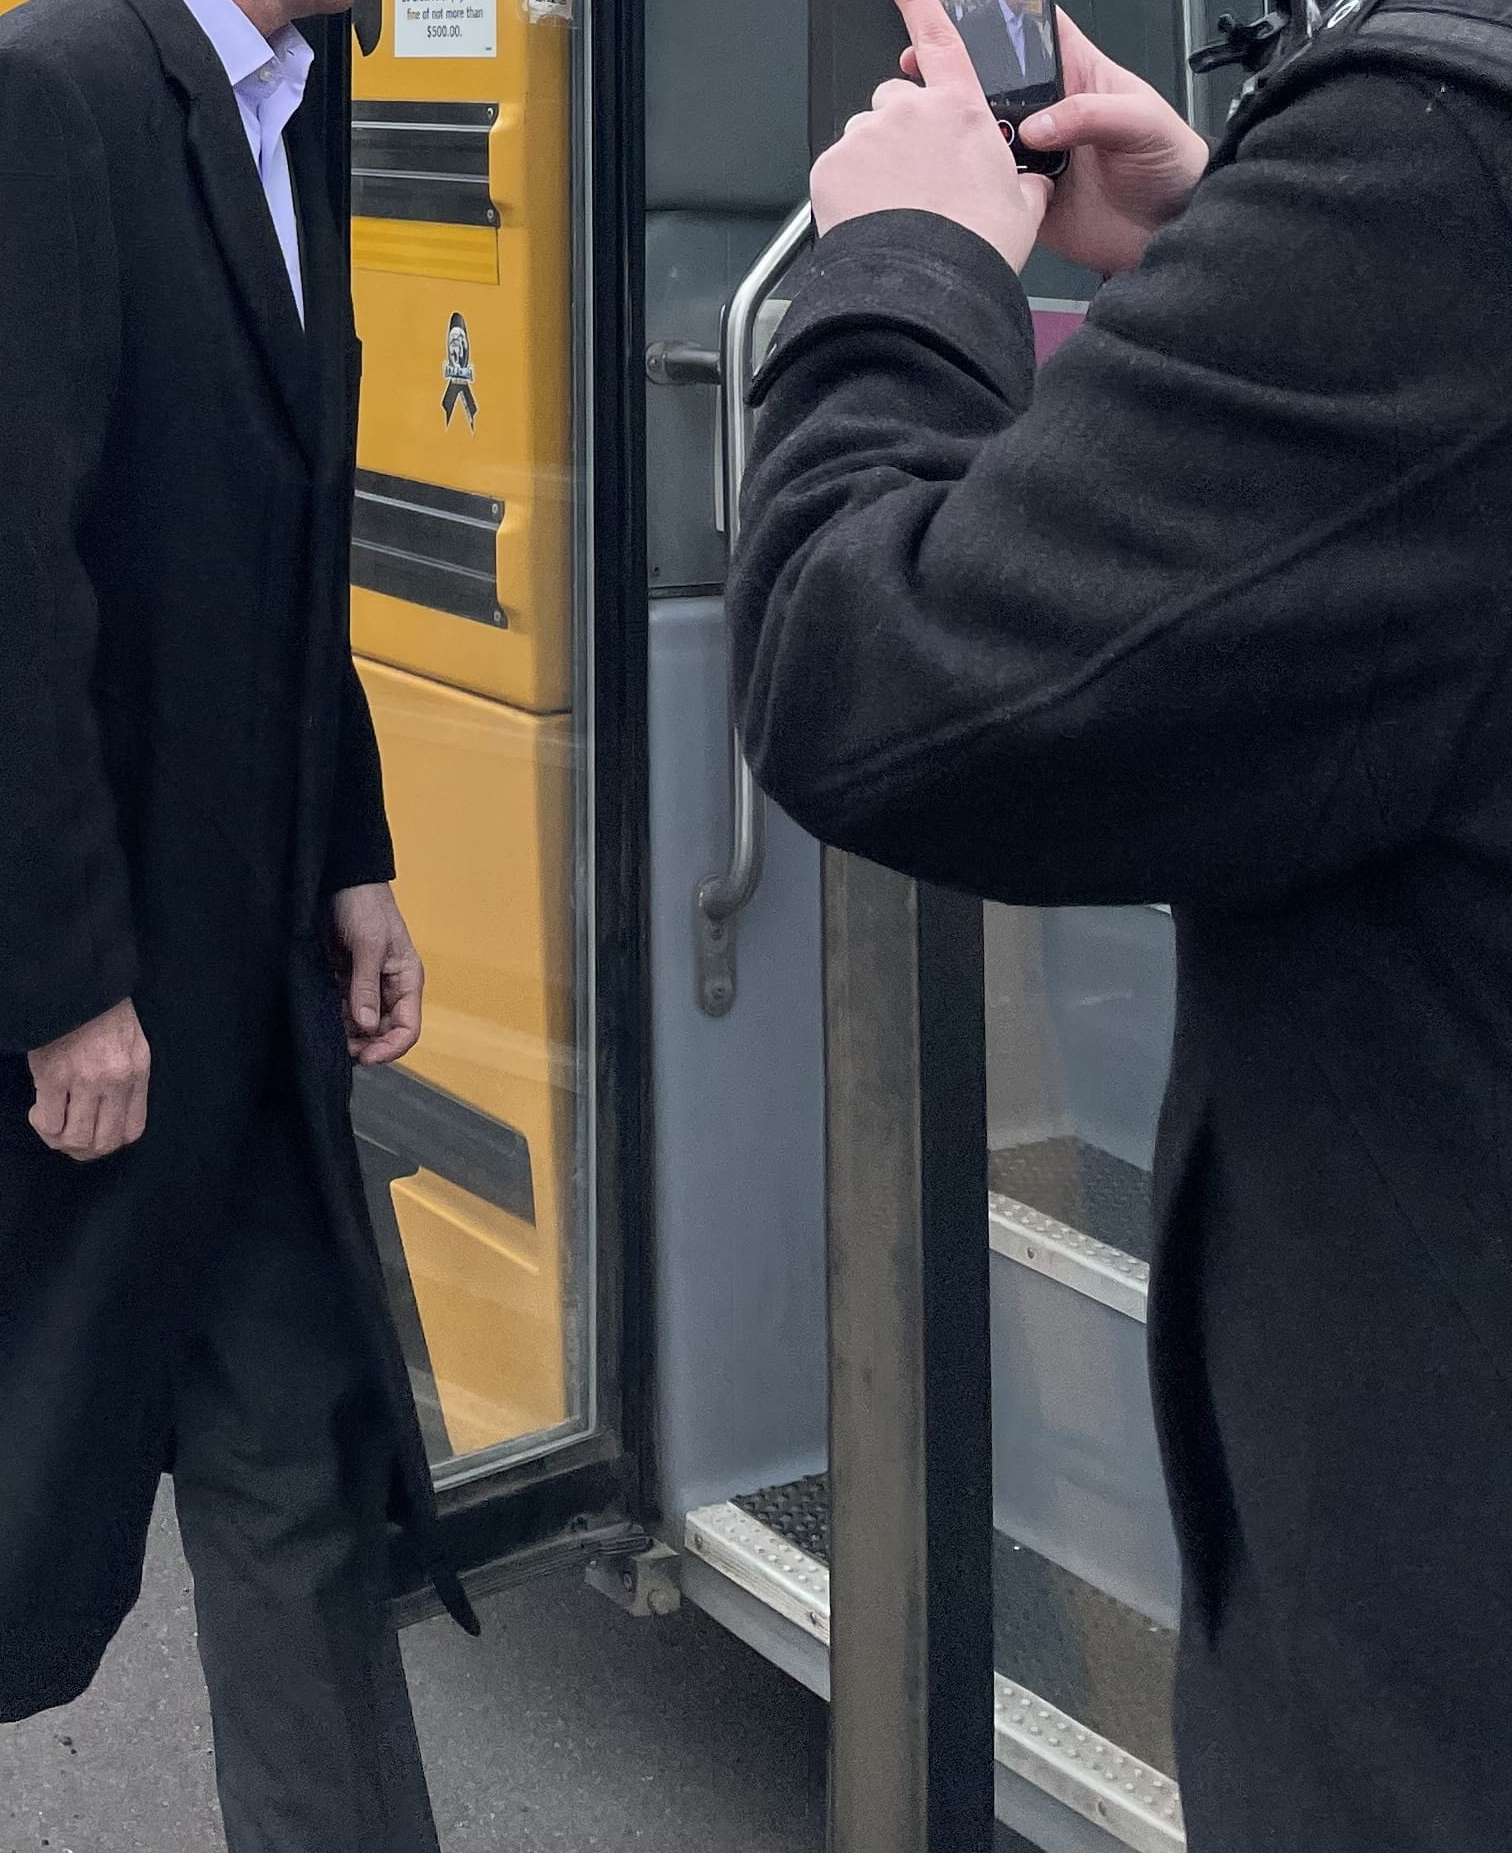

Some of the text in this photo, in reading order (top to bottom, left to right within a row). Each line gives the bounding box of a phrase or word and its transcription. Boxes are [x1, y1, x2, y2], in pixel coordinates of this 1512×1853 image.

[407, 6, 484, 20] fine of not more than
[427, 25, 463, 39] $500.00.
